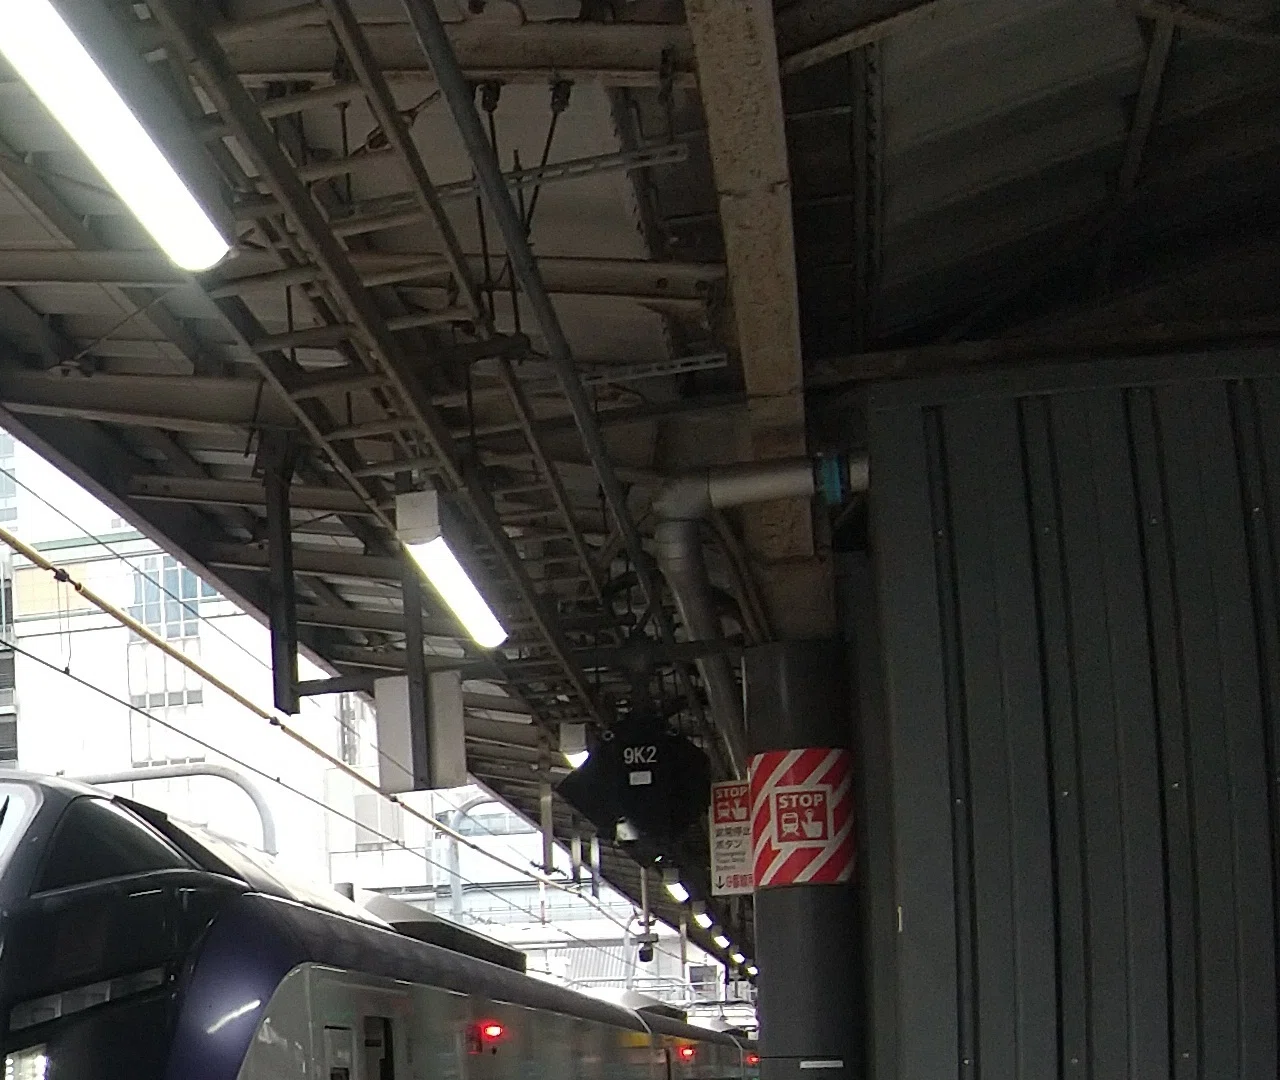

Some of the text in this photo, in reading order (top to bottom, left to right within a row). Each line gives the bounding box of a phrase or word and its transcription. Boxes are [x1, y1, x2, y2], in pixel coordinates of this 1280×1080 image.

[624, 746, 657, 764] 9K2
[716, 786, 748, 798] STOP
[779, 793, 823, 809] STOP
